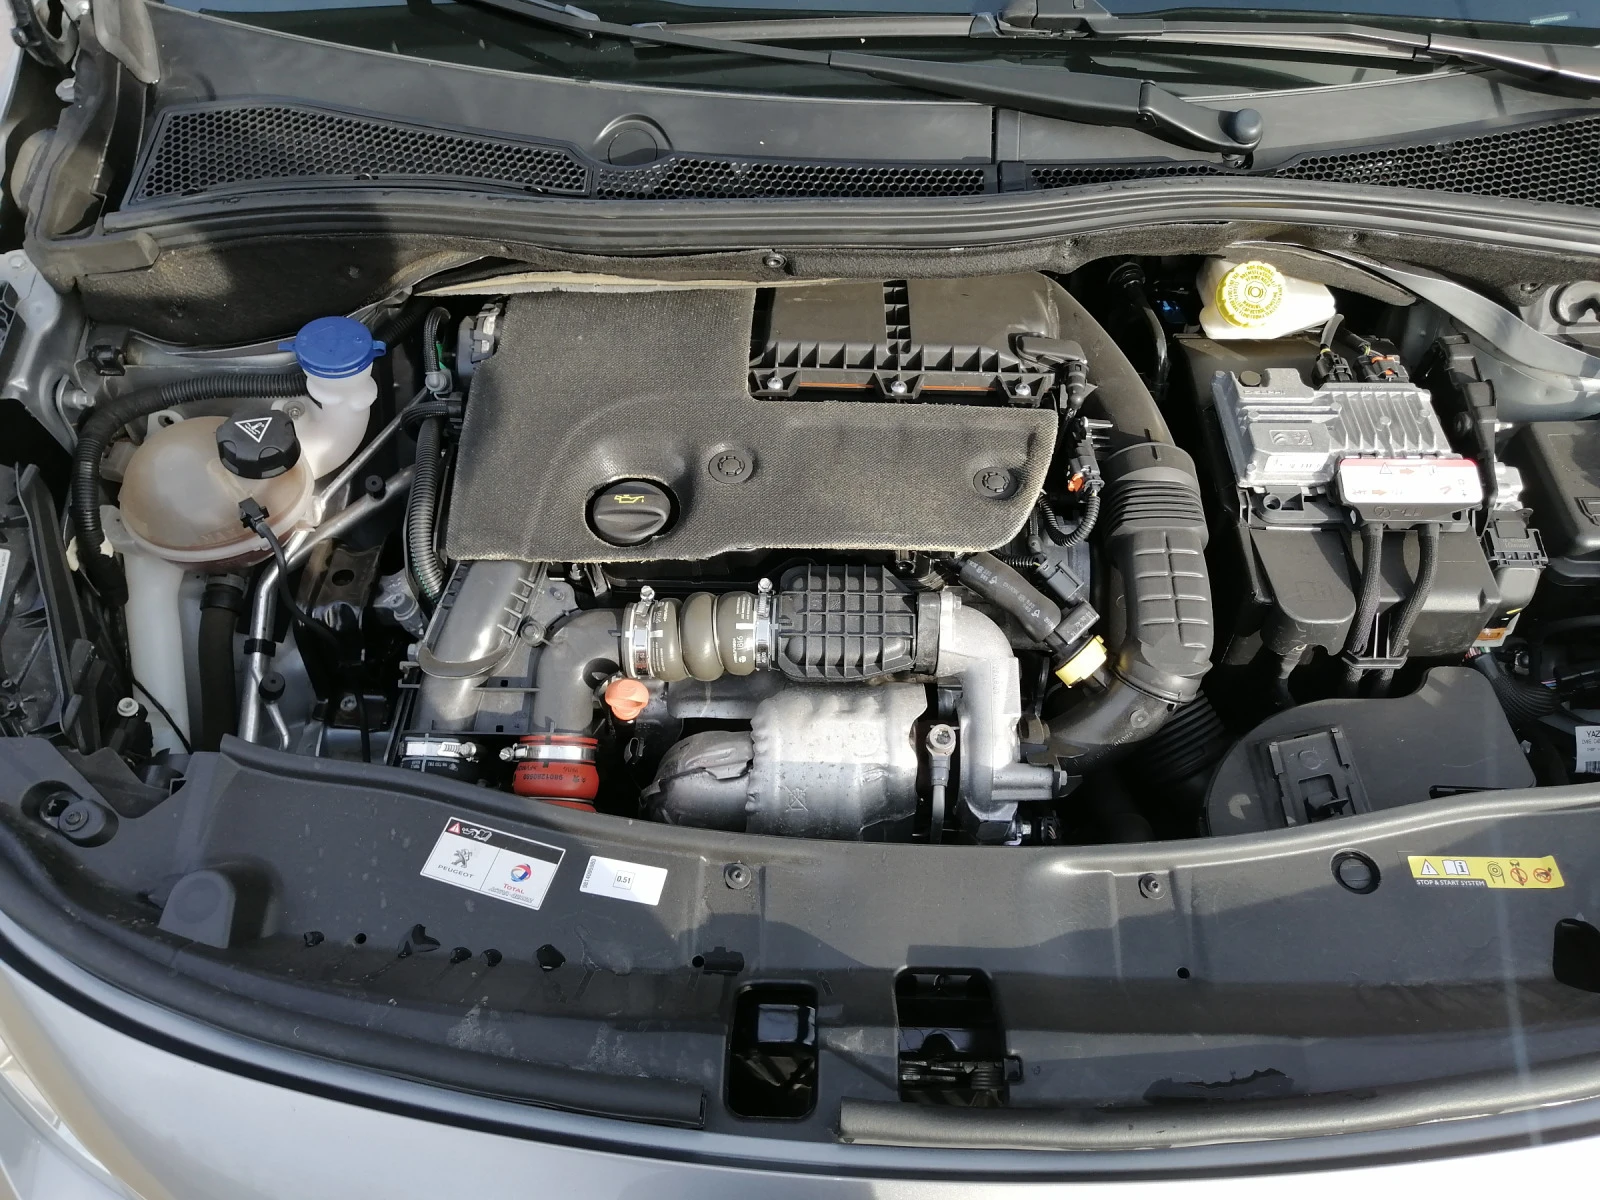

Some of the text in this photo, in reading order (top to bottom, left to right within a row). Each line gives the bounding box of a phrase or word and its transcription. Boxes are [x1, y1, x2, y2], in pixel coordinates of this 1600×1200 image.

[437, 864, 475, 878] PEUGEOT
[616, 875, 631, 884] 0.51
[503, 883, 525, 894] TOTAL
